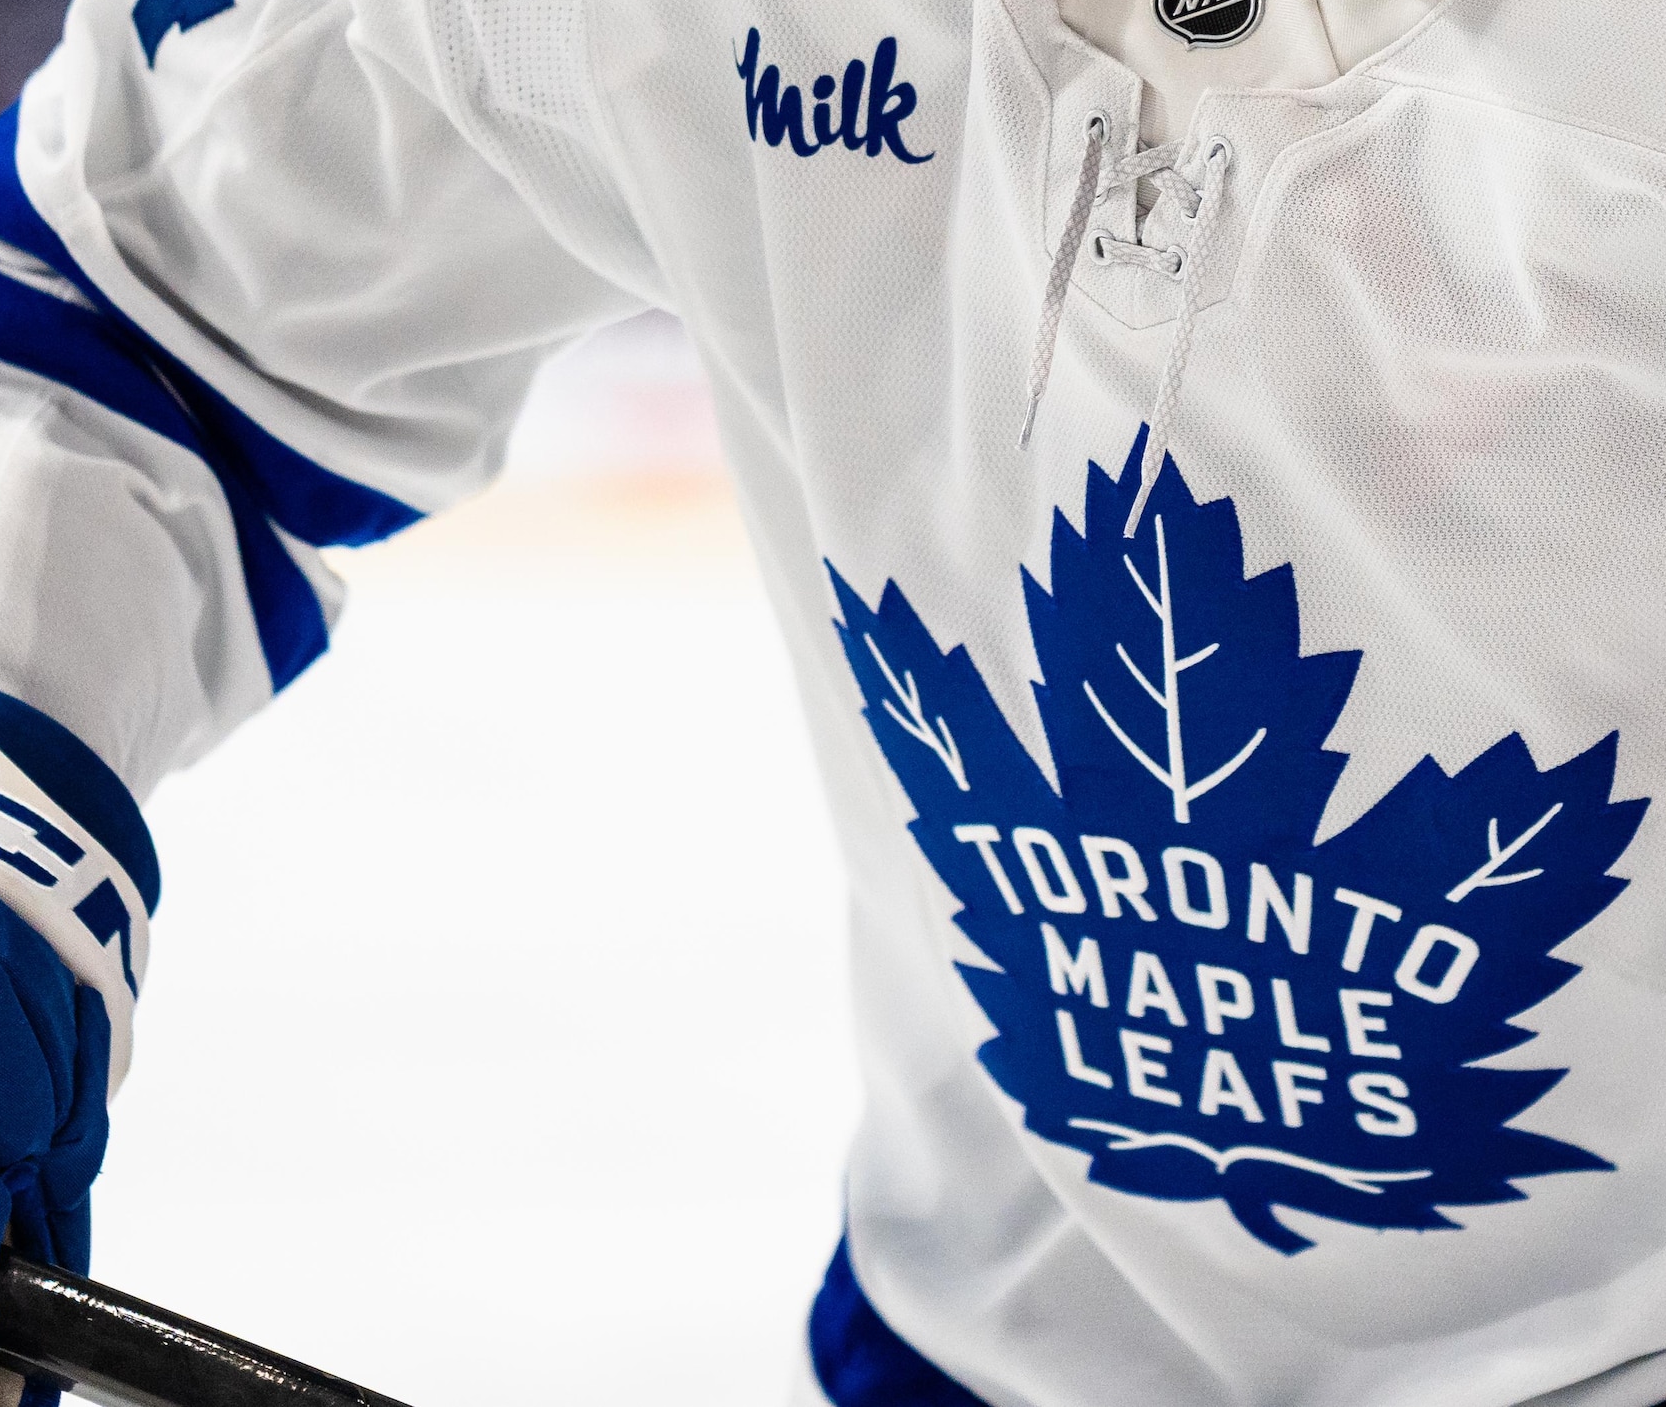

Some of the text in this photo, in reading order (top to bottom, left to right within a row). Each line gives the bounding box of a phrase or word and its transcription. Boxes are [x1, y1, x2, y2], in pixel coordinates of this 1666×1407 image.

[733, 27, 935, 164] Milk
[953, 824, 1481, 1005] TORONTO
[1041, 922, 1403, 1060] MAPLE
[1056, 1009, 1418, 1137] LEAFS
